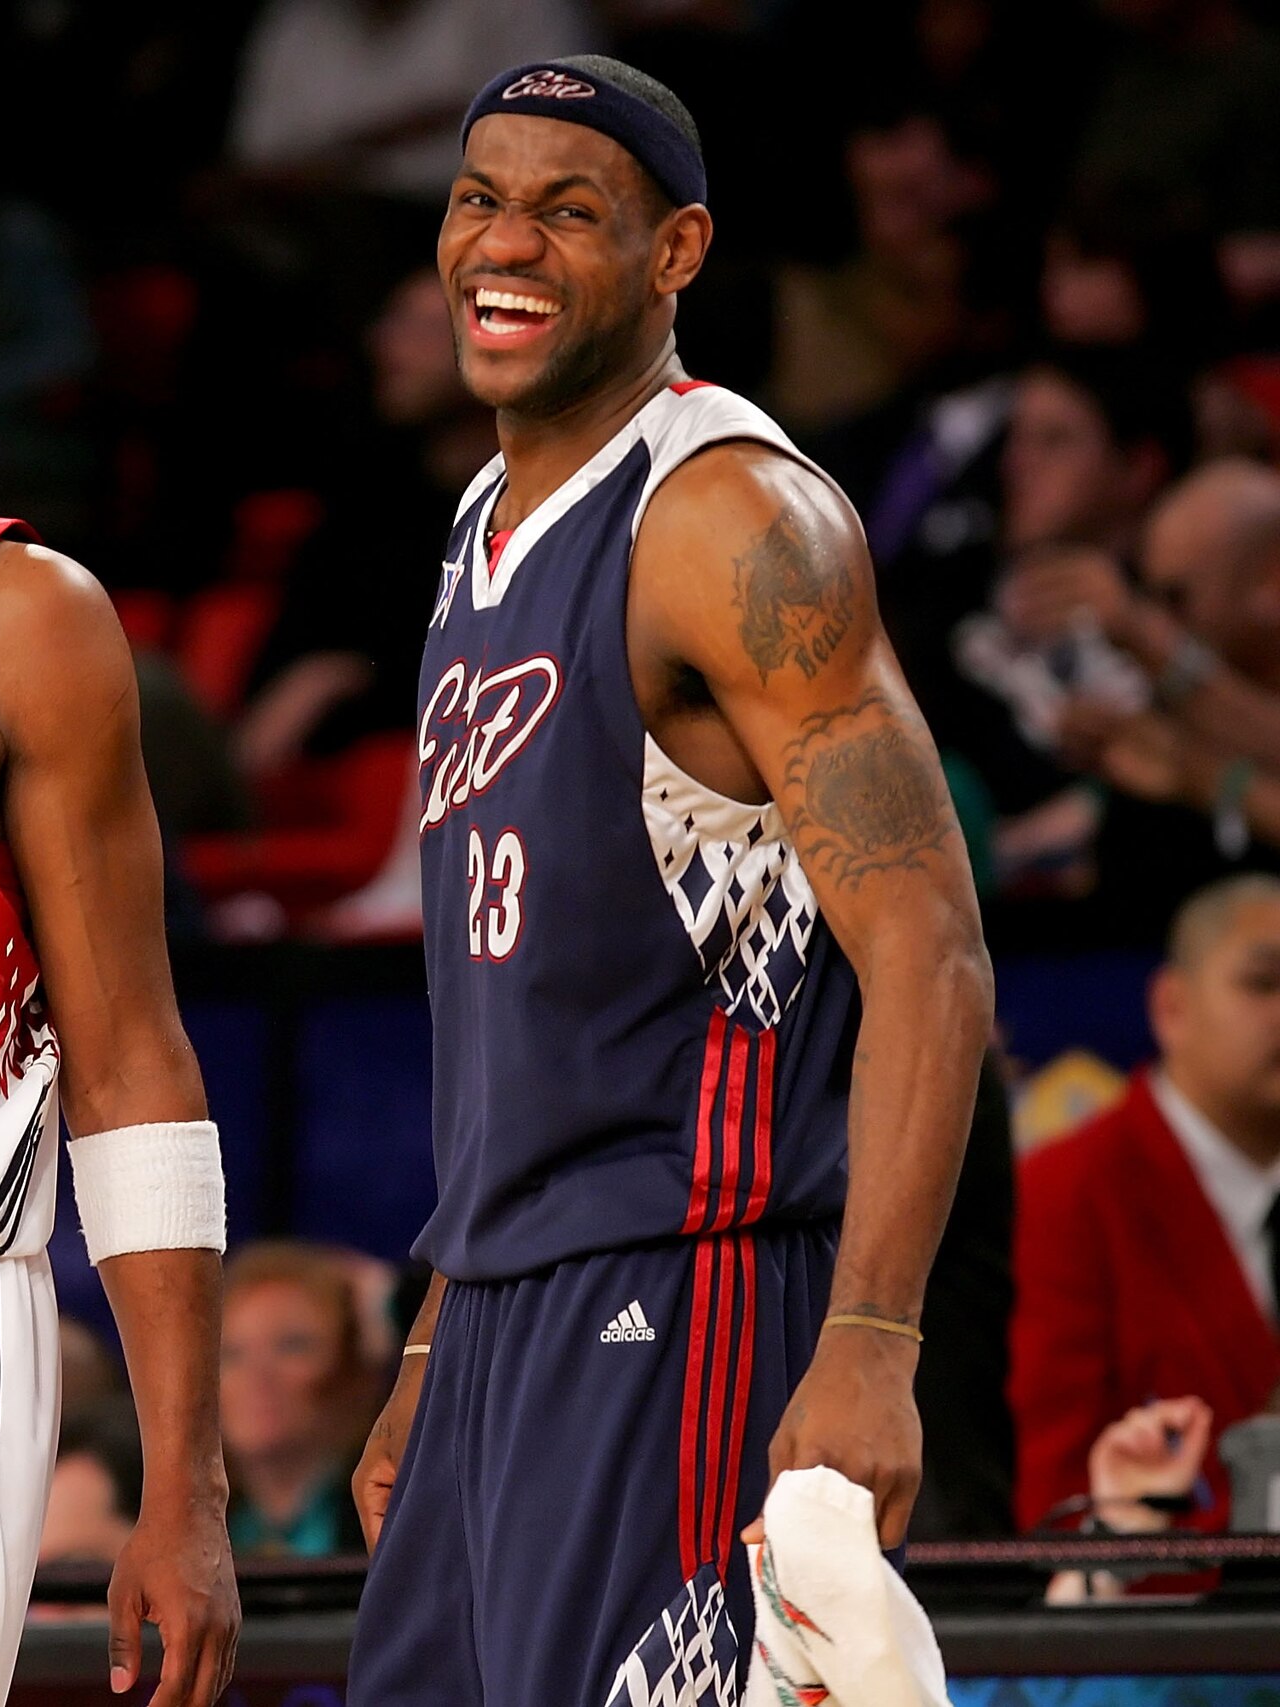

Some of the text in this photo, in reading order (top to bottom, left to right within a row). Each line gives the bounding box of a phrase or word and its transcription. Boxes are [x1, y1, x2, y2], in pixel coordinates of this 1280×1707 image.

[502, 70, 597, 100] East
[467, 825, 528, 965] 23
[600, 1326, 656, 1343] adidas
